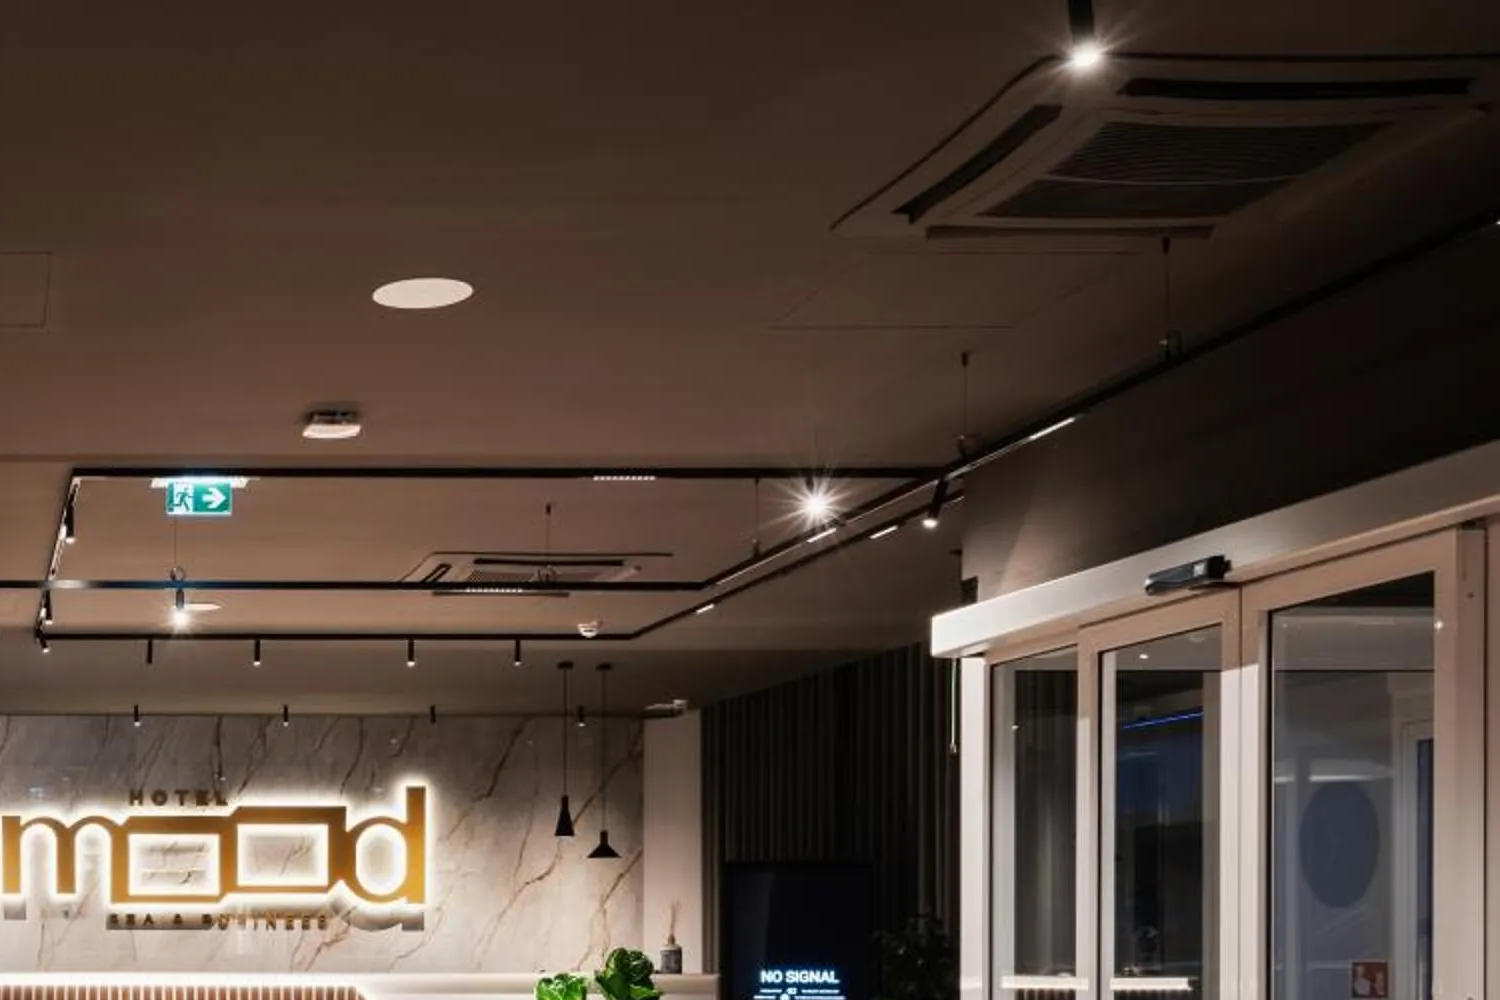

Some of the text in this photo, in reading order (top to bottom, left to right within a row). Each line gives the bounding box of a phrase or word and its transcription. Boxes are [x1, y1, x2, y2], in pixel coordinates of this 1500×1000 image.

[128, 788, 229, 806] HOTEL
[1, 785, 427, 904] mood
[760, 970, 841, 984] NO SIGNAL
